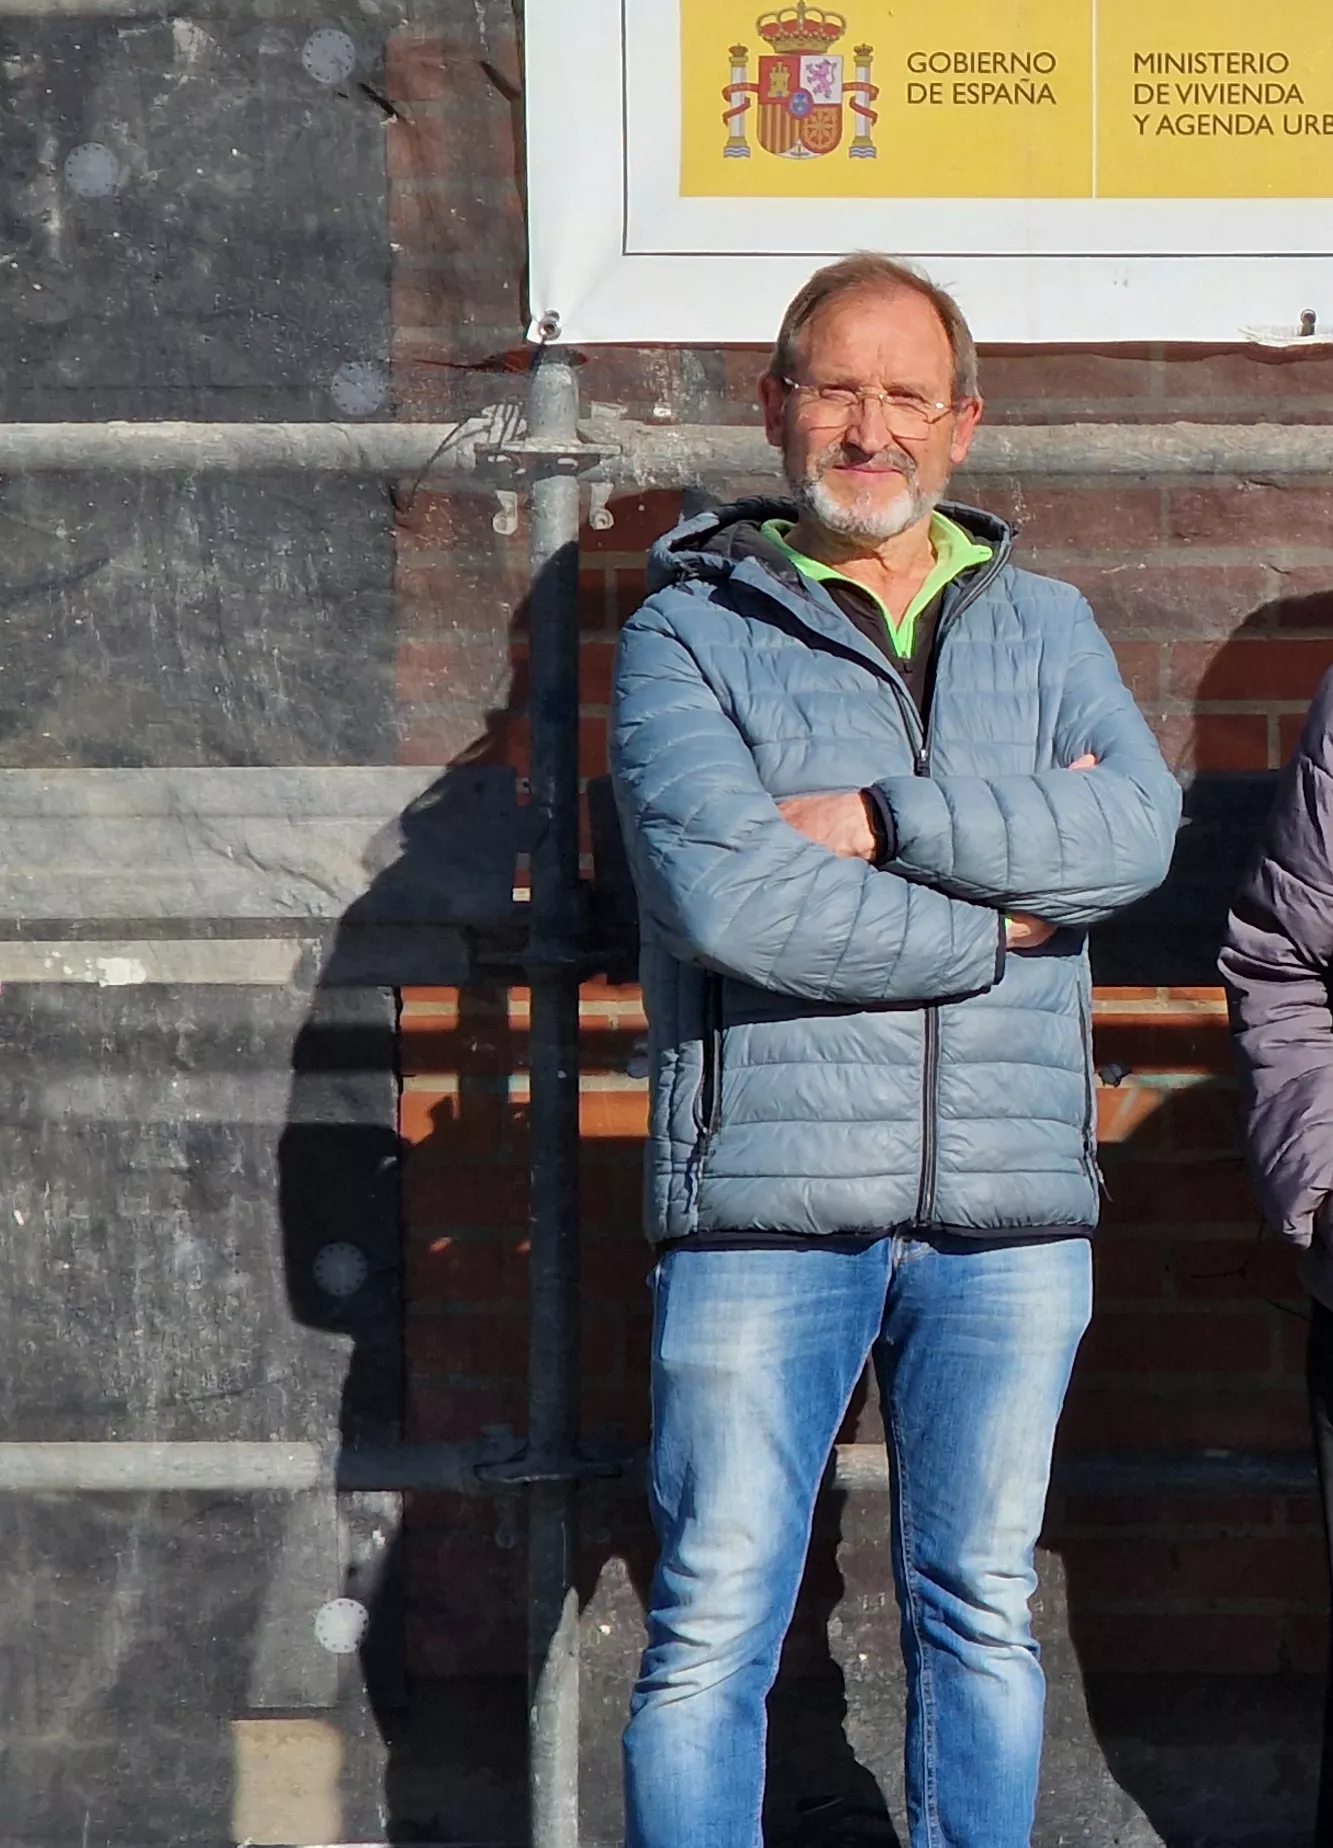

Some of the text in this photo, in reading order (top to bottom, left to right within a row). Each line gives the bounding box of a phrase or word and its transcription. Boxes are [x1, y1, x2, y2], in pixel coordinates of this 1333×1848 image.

[906, 51, 1057, 75] GOBIERNO
[1133, 51, 1290, 75] MINISTERIO
[906, 78, 1057, 106] DE ESPAÑA
[1133, 82, 1305, 106] DE VIVIENDA
[1133, 113, 1151, 137] Y
[1154, 113, 1274, 137] AGENDA
